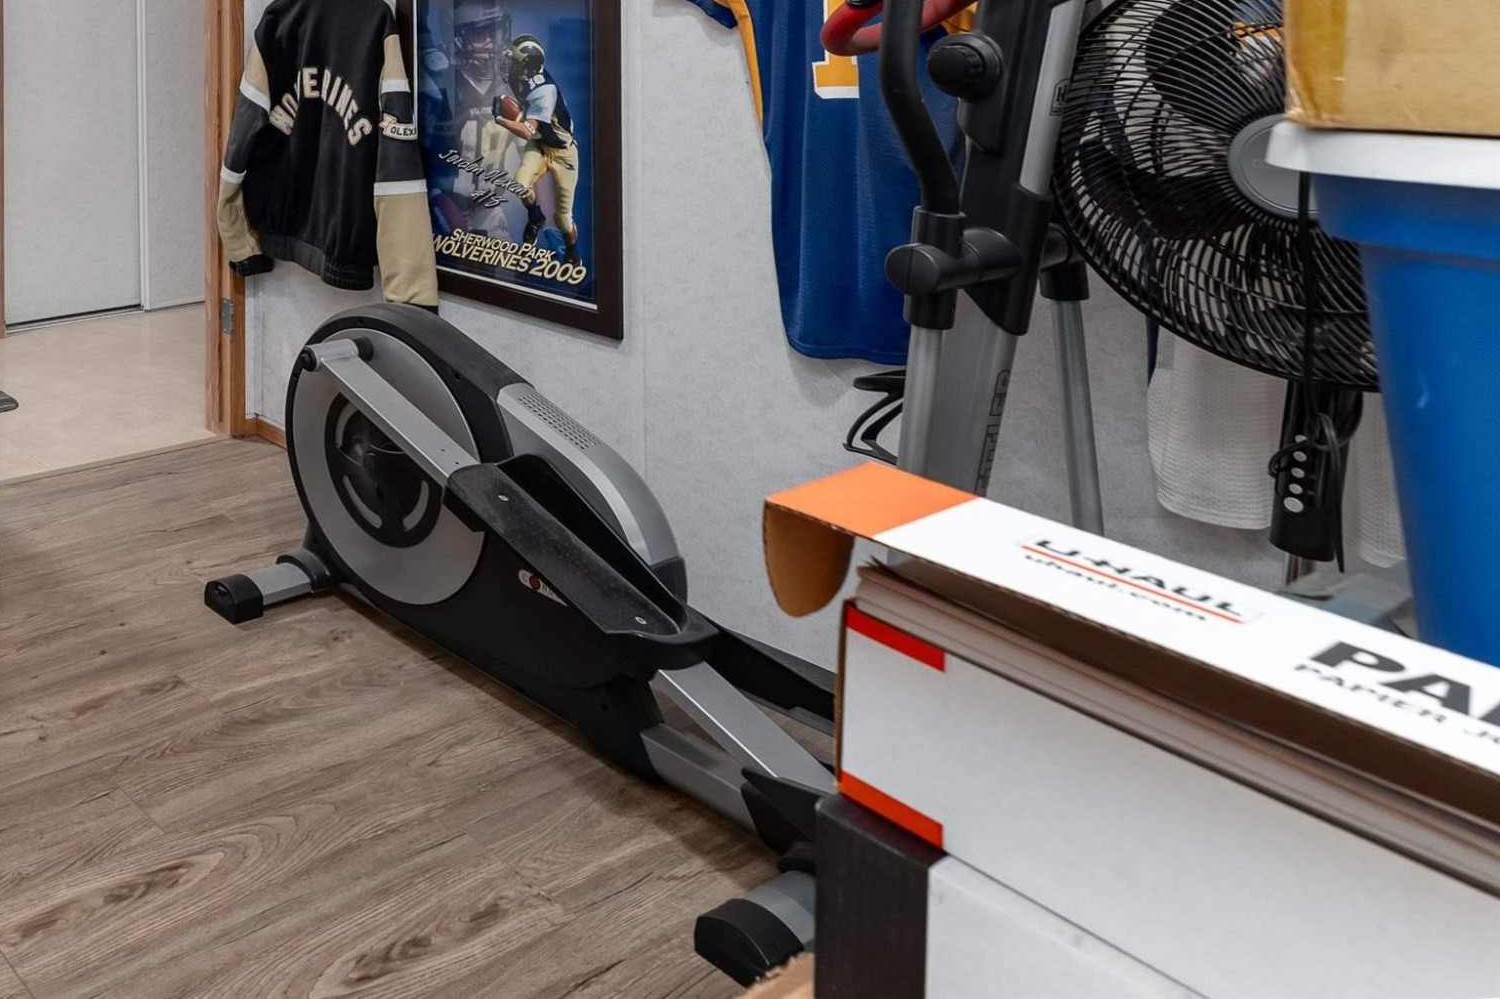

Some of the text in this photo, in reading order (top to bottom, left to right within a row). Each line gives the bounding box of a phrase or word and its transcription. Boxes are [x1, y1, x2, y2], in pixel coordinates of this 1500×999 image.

[450, 228, 555, 262] SHERWOOD PARK
[529, 257, 587, 286] 2009
